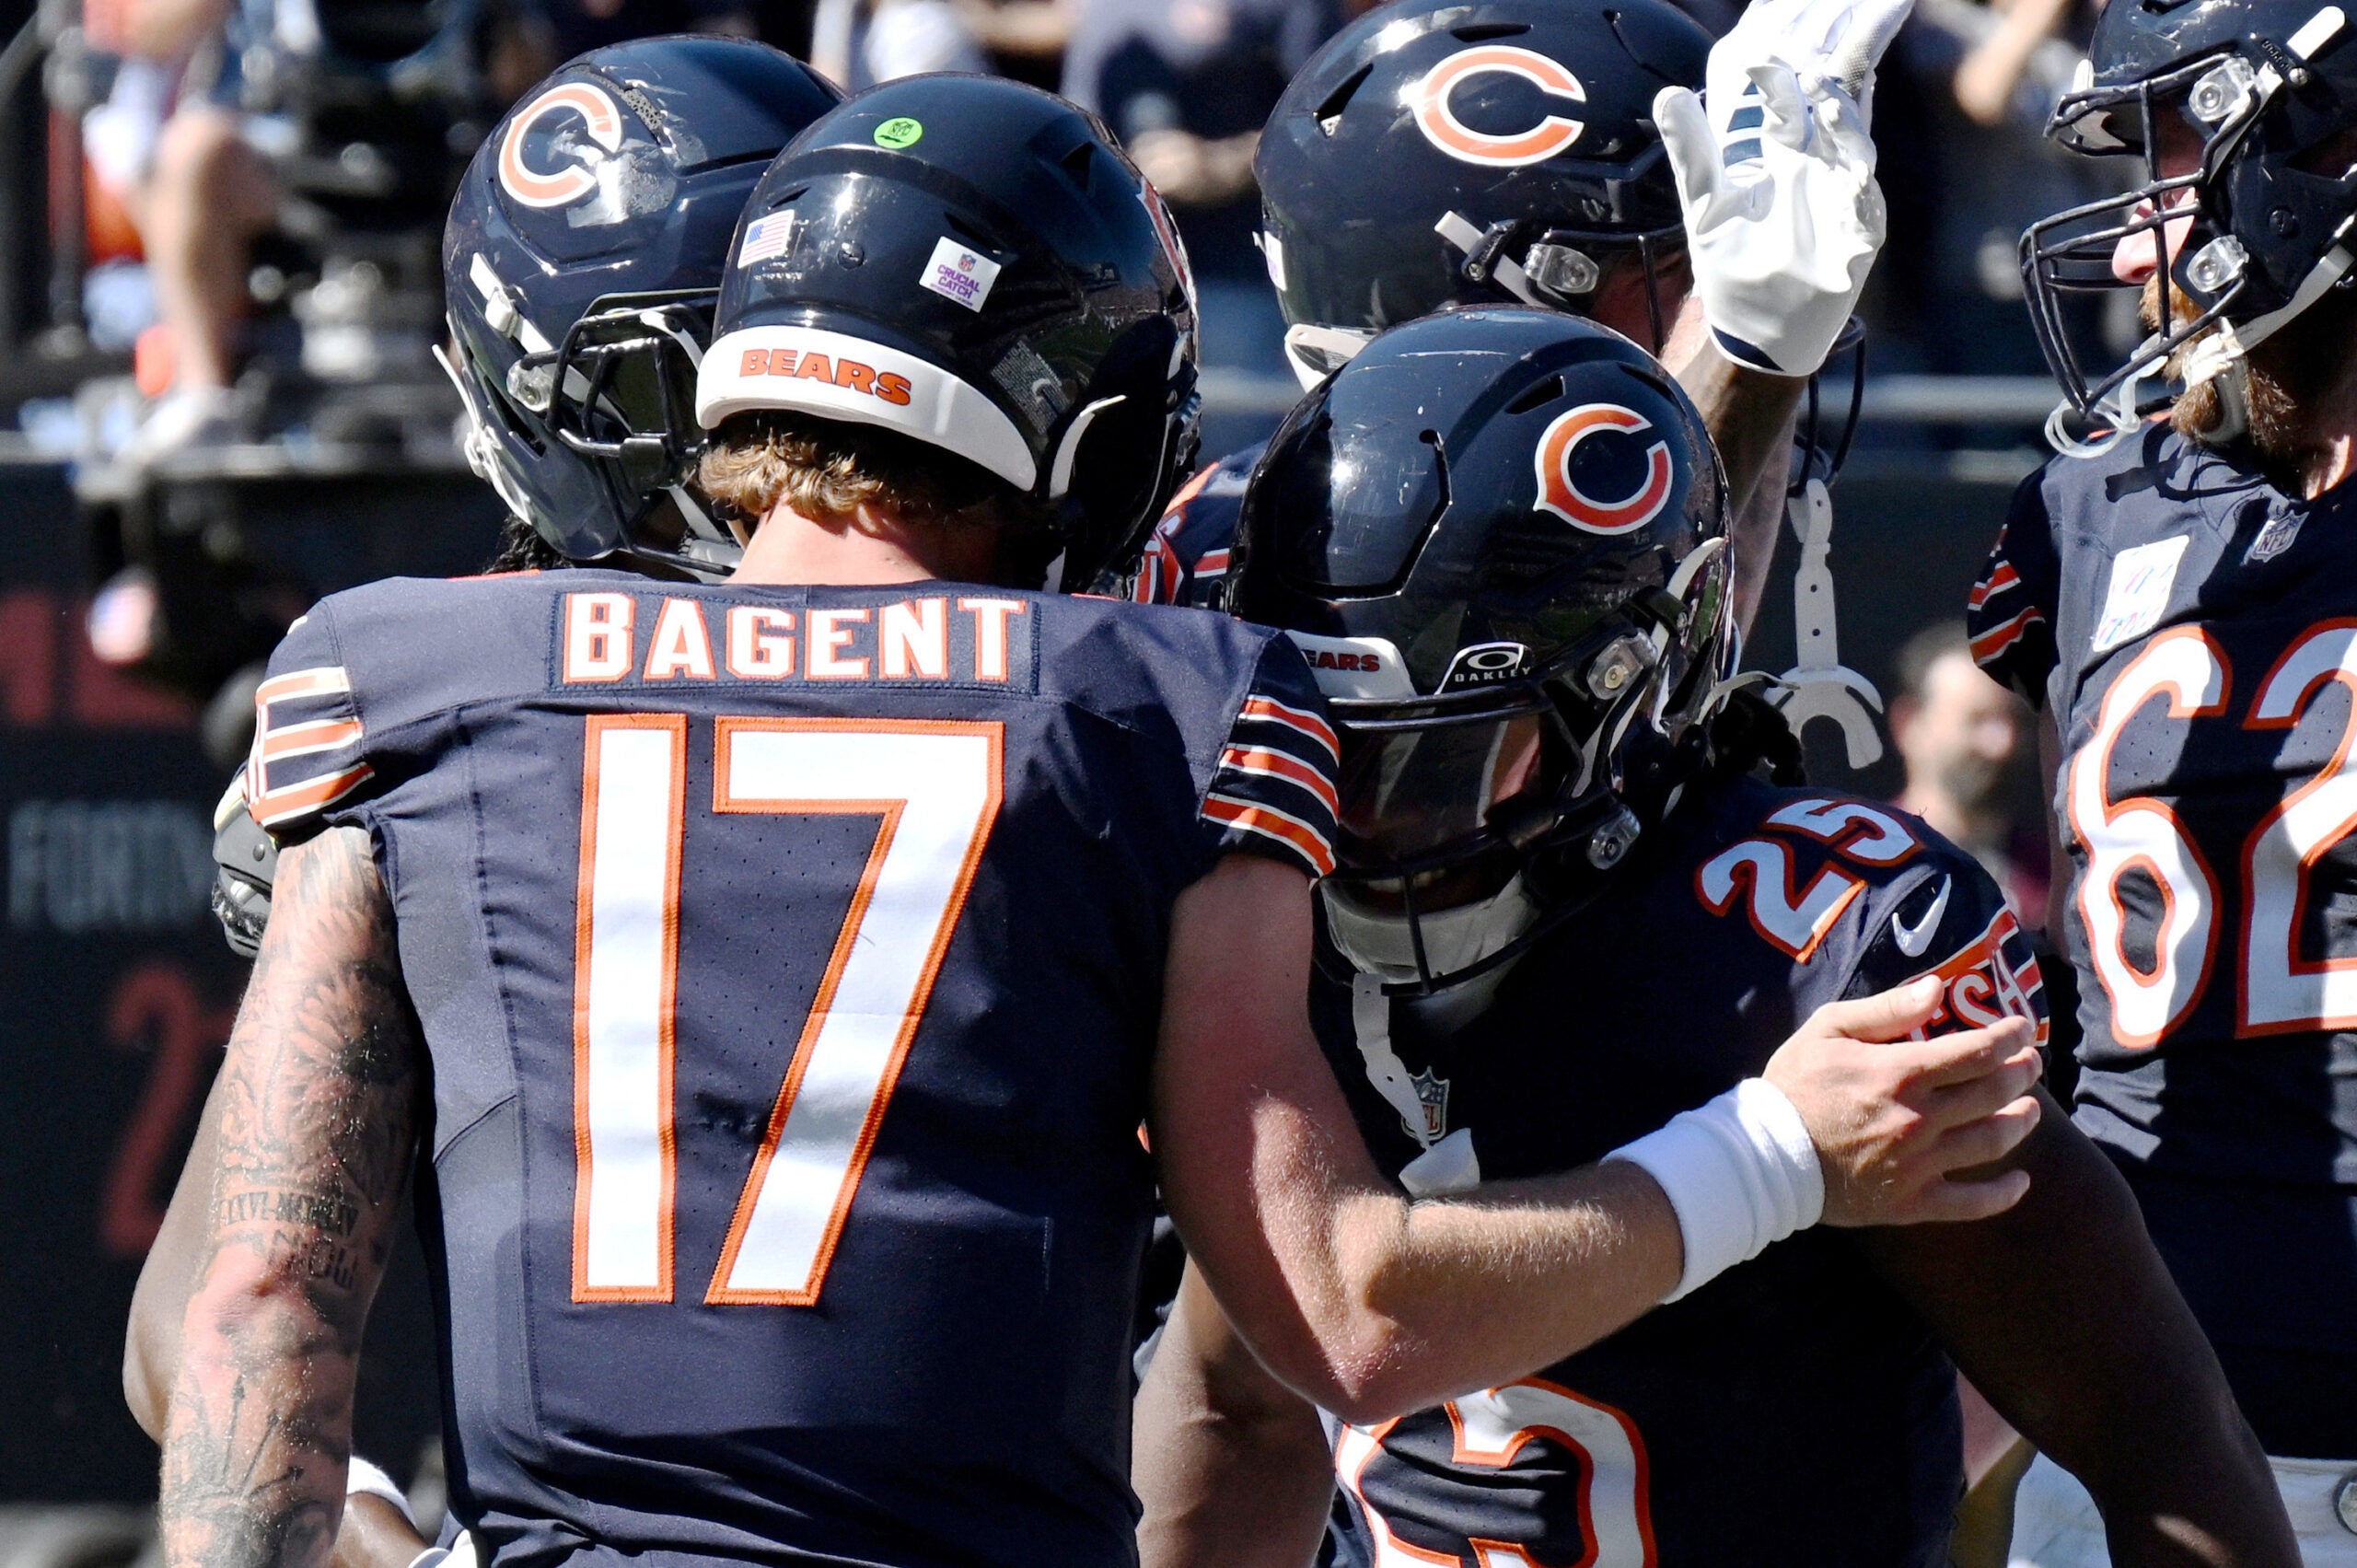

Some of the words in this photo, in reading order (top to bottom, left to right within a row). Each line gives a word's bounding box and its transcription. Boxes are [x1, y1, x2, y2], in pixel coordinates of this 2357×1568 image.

[937, 264, 980, 293] CRUCIAL
[938, 276, 972, 299] CATCH
[739, 349, 911, 405] BEARS
[563, 592, 1027, 682] BAGENT
[1300, 649, 1380, 672] EARS
[1455, 667, 1531, 682] OAKLEY
[2068, 616, 2357, 1049] 62
[1694, 797, 1926, 964] 25
[571, 713, 1005, 1306] 17
